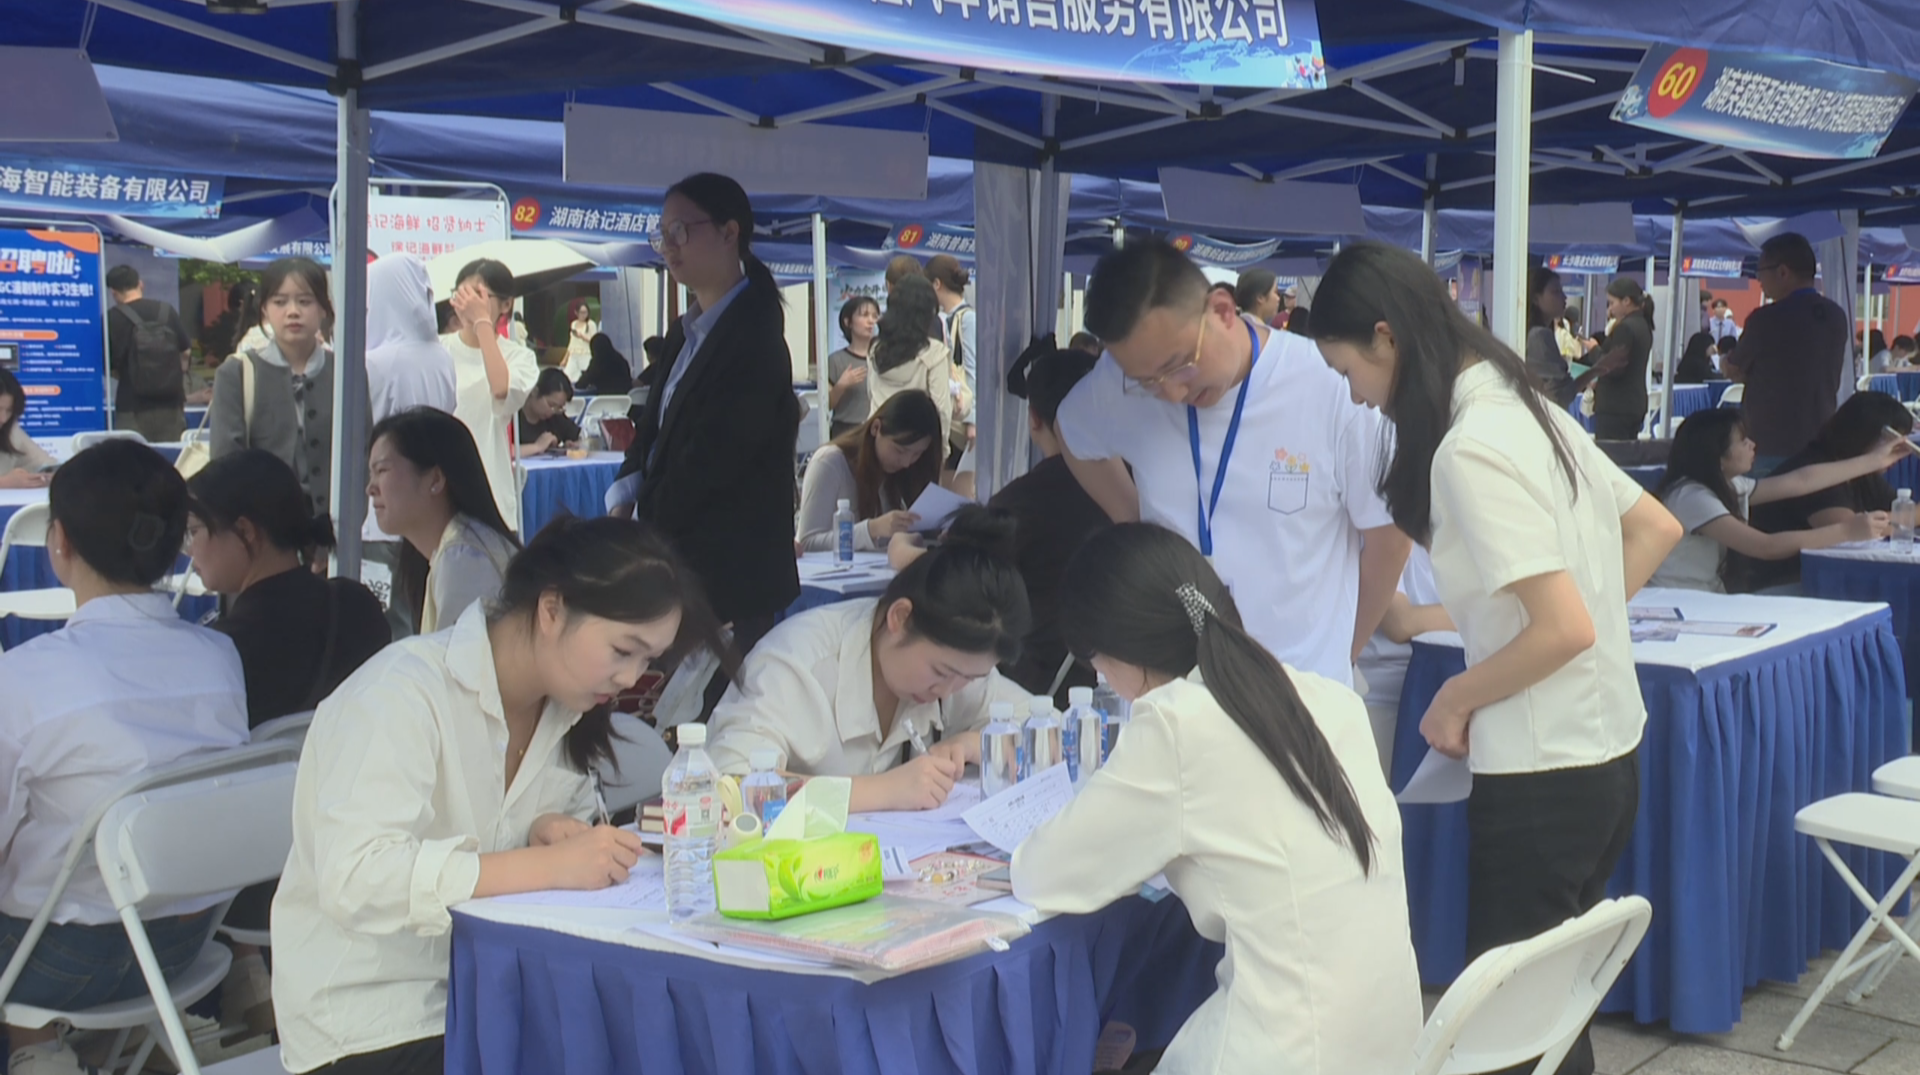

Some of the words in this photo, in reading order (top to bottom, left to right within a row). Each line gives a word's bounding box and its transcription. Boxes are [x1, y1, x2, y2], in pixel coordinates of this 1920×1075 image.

[871, 0, 1289, 47] 销售服务有限公司
[1657, 62, 1697, 100] 60
[0, 165, 209, 204] 海智能装备有限公司
[514, 205, 536, 222] 82
[549, 206, 661, 233] 湖南徐记酒店管
[901, 229, 918, 243] 81
